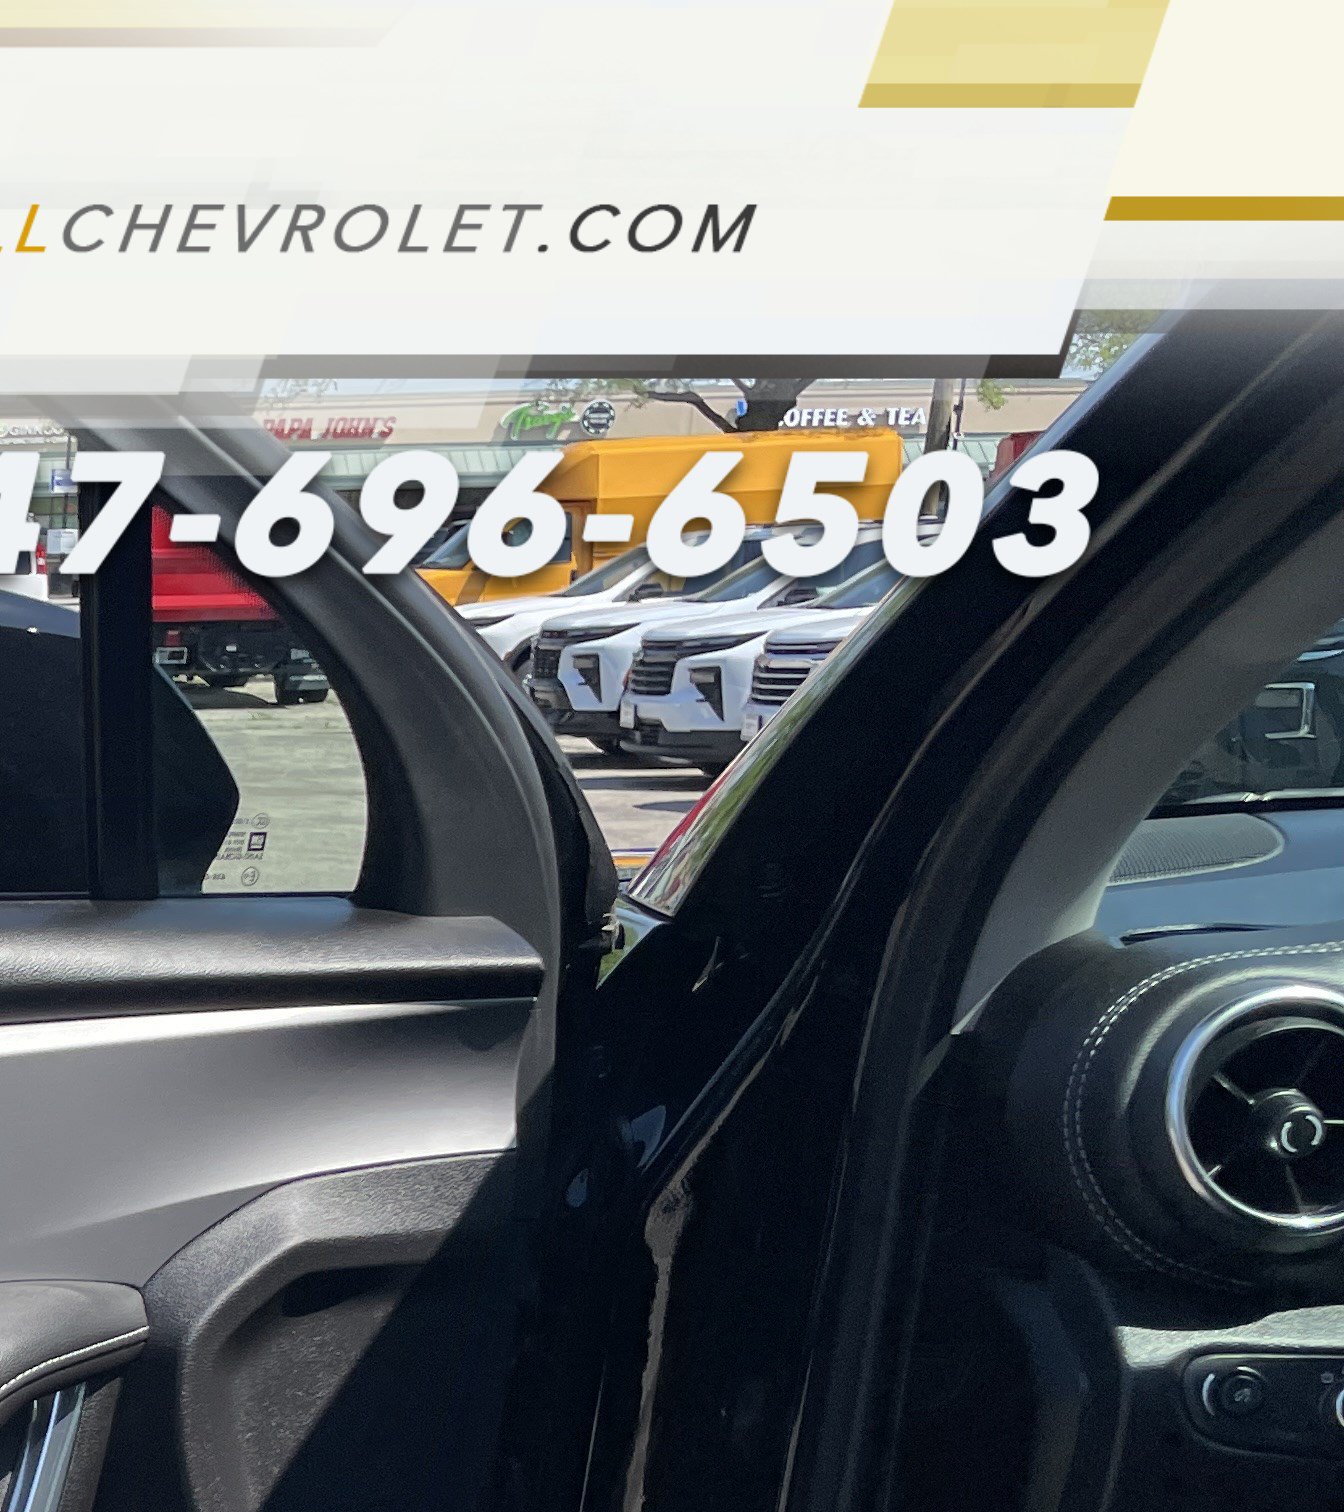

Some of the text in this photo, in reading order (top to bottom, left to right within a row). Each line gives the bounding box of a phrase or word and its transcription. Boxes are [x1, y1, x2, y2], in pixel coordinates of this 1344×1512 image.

[778, 407, 927, 427] OFFEE & TEA
